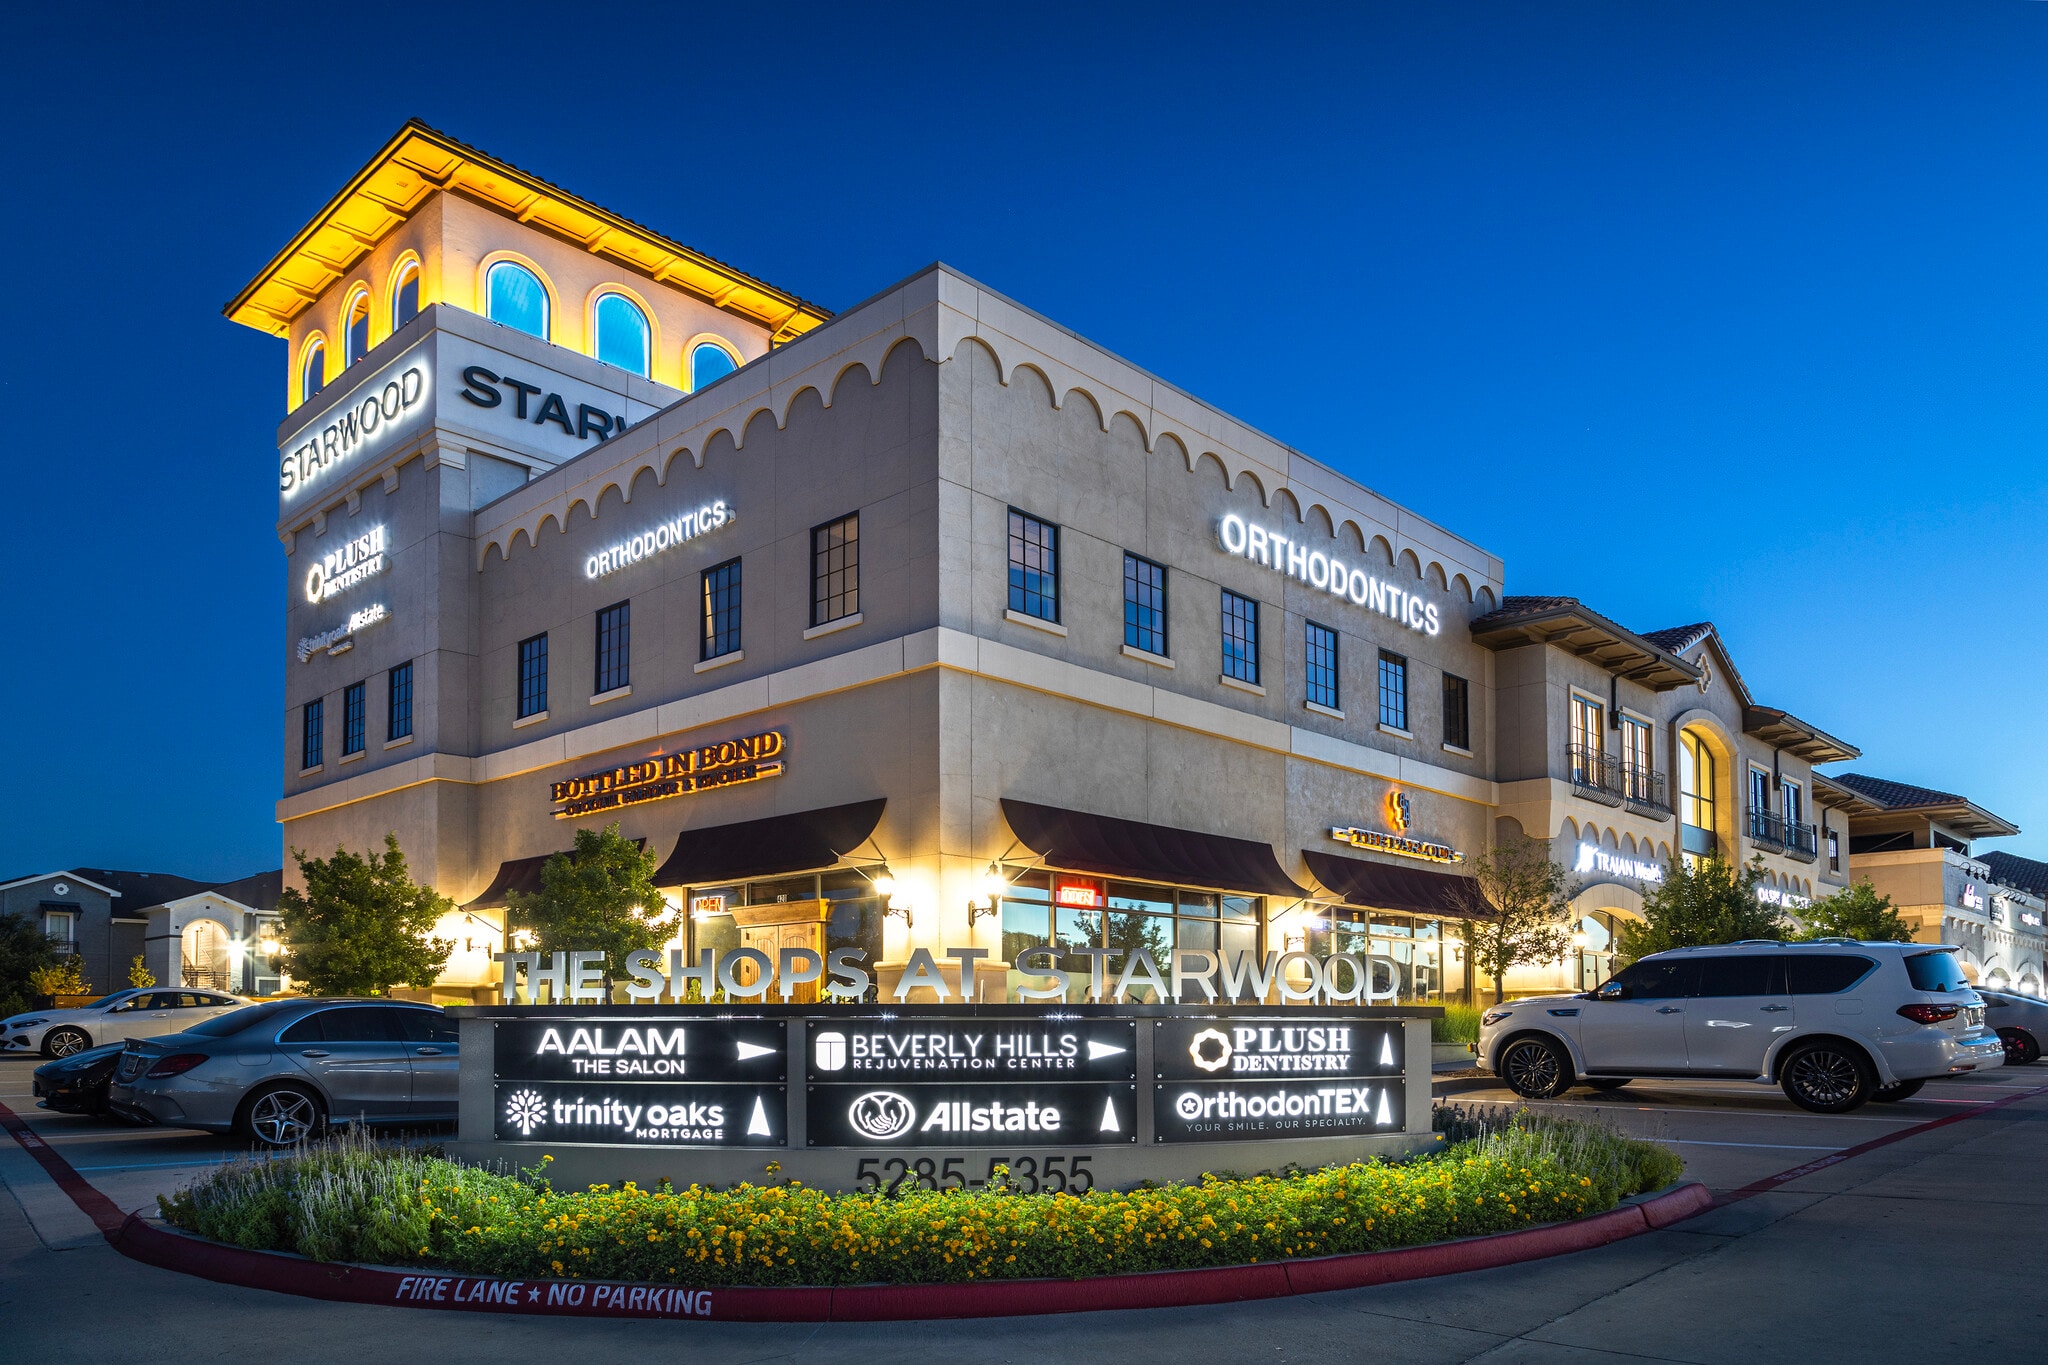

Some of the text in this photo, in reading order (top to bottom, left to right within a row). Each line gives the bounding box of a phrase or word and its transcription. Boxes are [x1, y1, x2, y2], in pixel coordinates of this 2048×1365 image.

[461, 365, 630, 442] STAR
[280, 367, 424, 492] STARWOOD
[323, 524, 386, 581] PLUSH
[586, 500, 726, 579] ORTHODONTICS
[323, 553, 384, 598] DENTISTRY
[1220, 514, 1440, 636] ORTHODONTICS
[348, 603, 385, 634] Allstate
[550, 731, 784, 803] BOTTLED IN BOND
[564, 765, 758, 816] COCKTAIL PARLOUR & KITCHEN
[1351, 829, 1456, 861] THE PARLOUR
[1596, 852, 1634, 877] TRAJAN
[694, 897, 722, 913] OPEN
[1062, 889, 1094, 906] OPEN
[494, 947, 1401, 1001] THE SHOPS AT STARWOOD
[536, 1028, 686, 1056] AALAM
[853, 1034, 1078, 1058] BEVERLY HILLS
[1232, 1027, 1351, 1053] PLUSH
[572, 1059, 686, 1074] THE SALON
[853, 1058, 1076, 1069] REJUVENATION CENTER
[1232, 1054, 1351, 1072] DENTISTRY
[552, 1097, 725, 1132] trinity oaks
[920, 1101, 1061, 1132] Allstate
[1175, 1087, 1371, 1121] OrthodonTEX
[635, 1128, 724, 1140] MORTGAGE
[1185, 1116, 1367, 1133] YOUR SMILE. OUR SPECIALTY.
[855, 1155, 1095, 1197] 5285-5355
[395, 1276, 714, 1317] FIRE LANE NO PARKING
